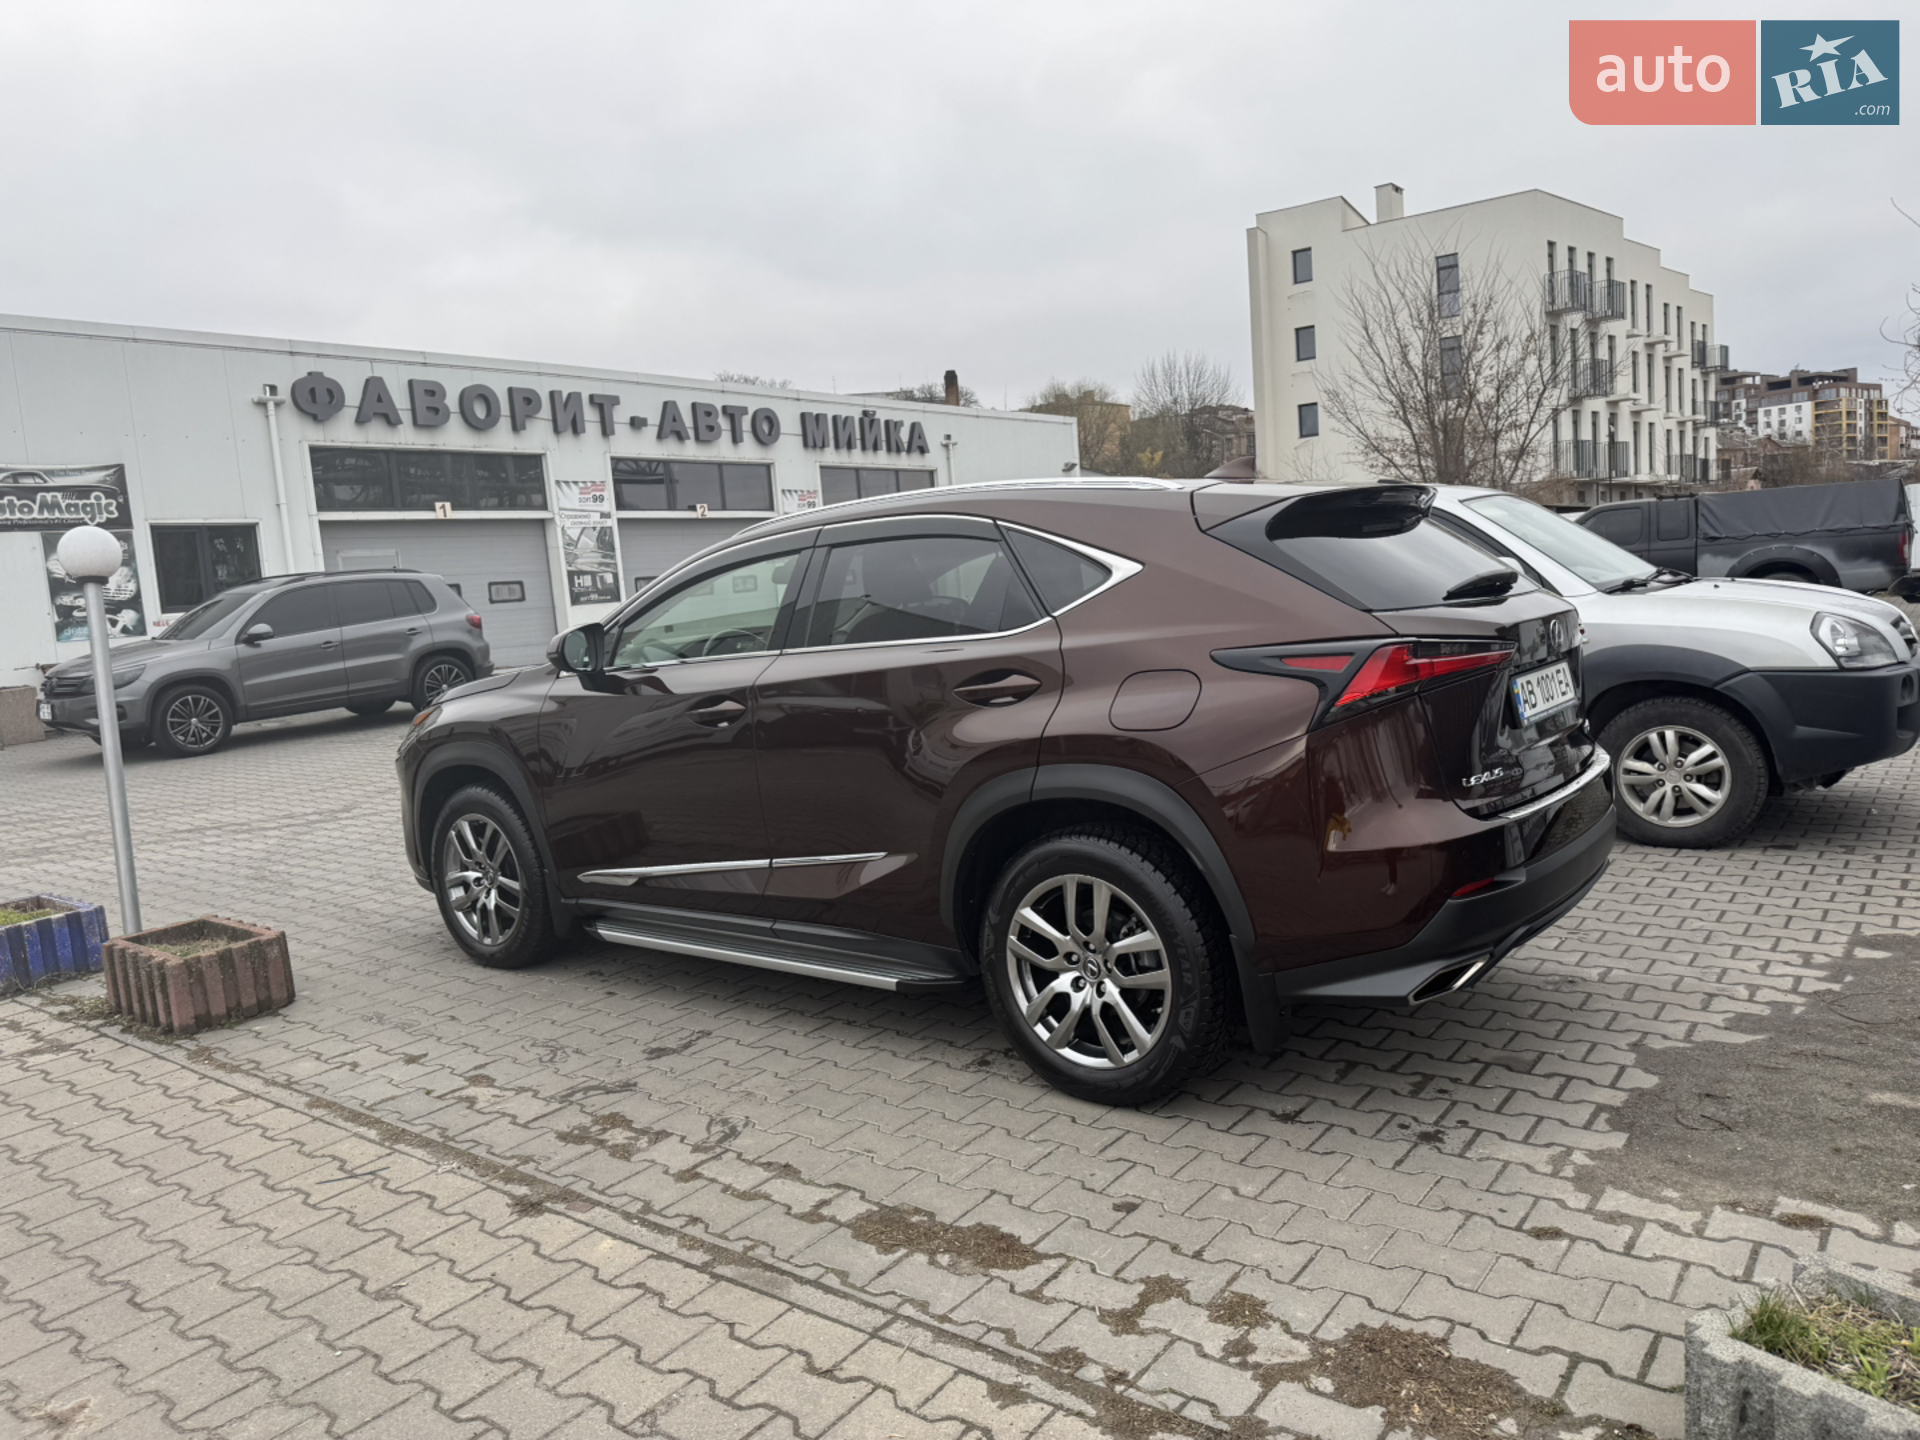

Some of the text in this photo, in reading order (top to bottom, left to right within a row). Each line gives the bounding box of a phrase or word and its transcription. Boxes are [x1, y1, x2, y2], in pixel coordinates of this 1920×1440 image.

[801, 410, 930, 454] МИЙКА
[439, 503, 447, 518] 1
[699, 504, 708, 517] 2
[1520, 679, 1538, 712] AB
[1461, 766, 1504, 788] LEXUS
